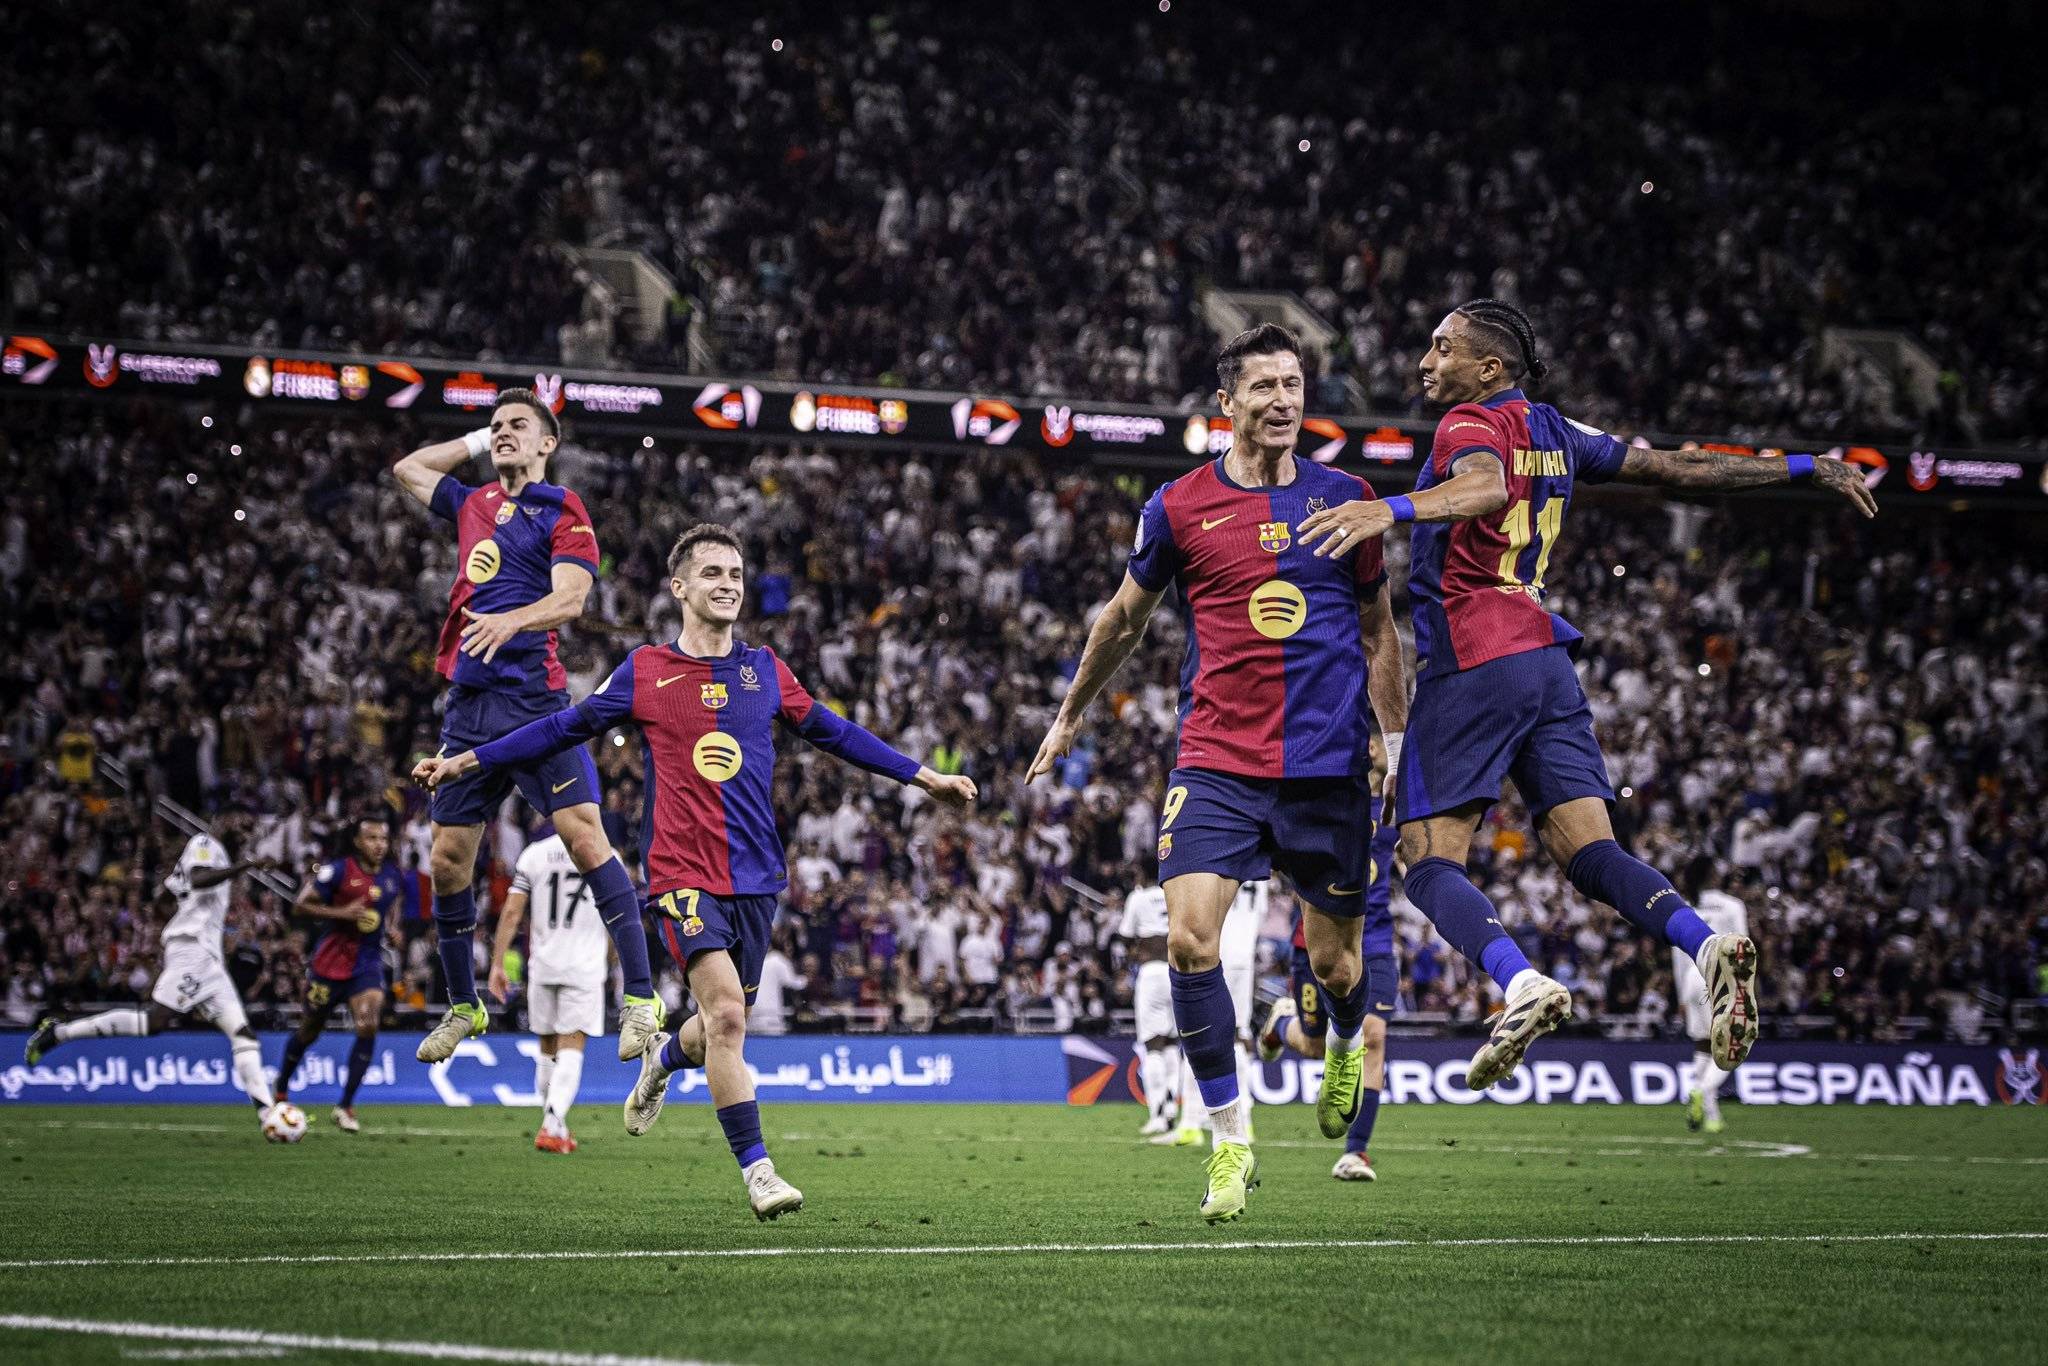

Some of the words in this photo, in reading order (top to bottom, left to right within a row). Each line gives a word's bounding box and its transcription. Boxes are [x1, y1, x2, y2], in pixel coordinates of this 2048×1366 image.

[1498, 497, 1565, 589] 11
[1161, 786, 1188, 830] 9
[546, 870, 588, 929] 17
[658, 888, 700, 924] 17
[1301, 982, 1317, 1013] 8
[1250, 1059, 1624, 1105] UPRCOPA
[1734, 1051, 1991, 1106] ESPAÑA
